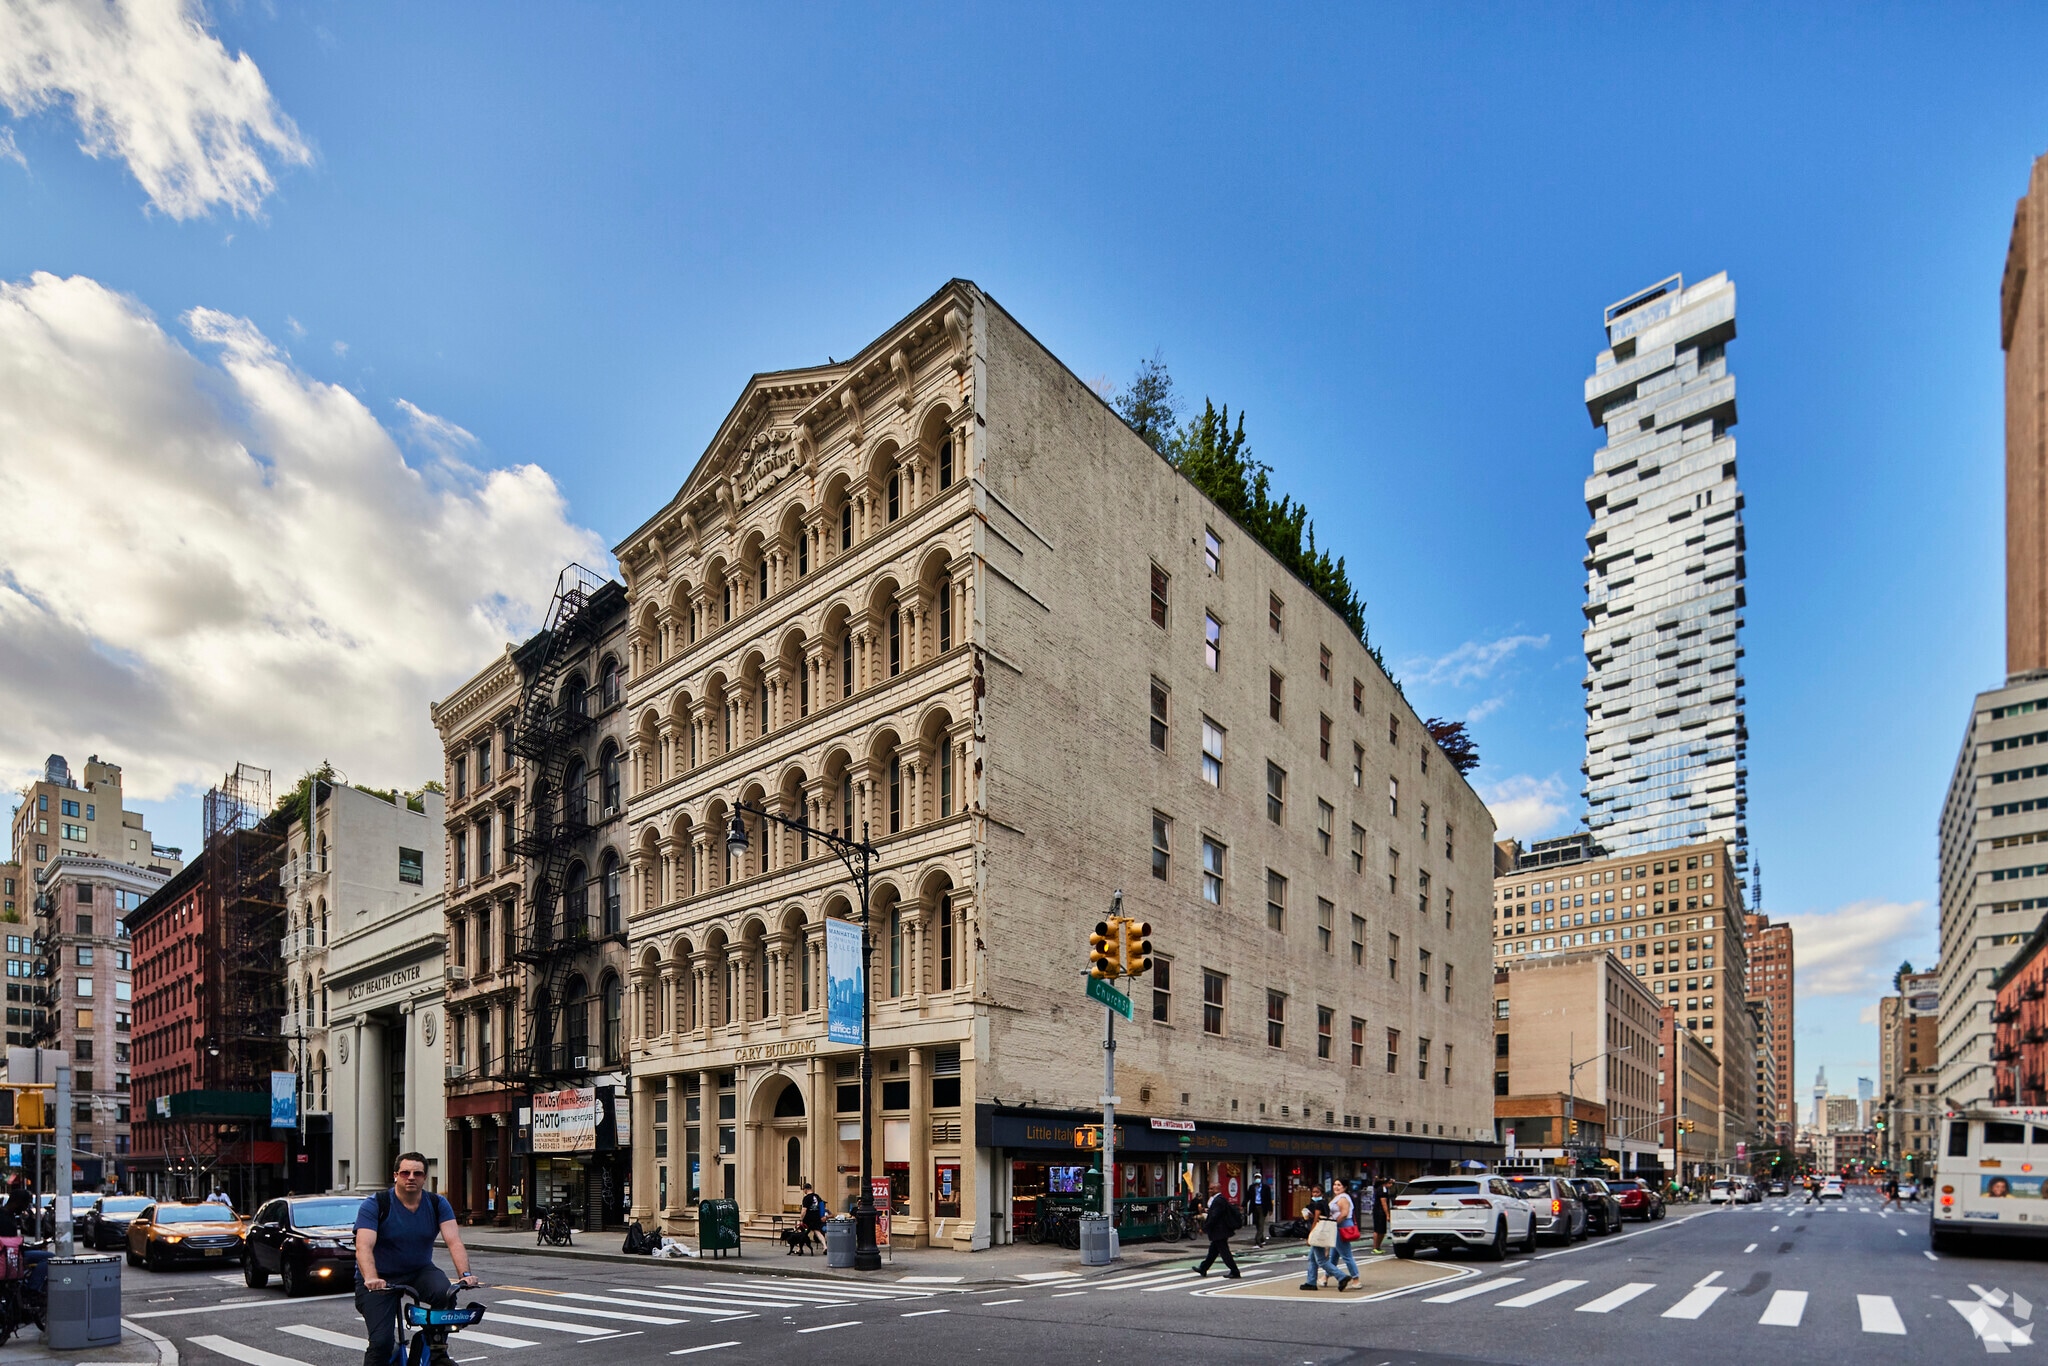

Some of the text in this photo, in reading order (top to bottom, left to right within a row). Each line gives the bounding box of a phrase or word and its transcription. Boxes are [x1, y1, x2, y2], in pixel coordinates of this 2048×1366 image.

[740, 448, 795, 497] BUILDING
[366, 976, 391, 994] HEALTH
[392, 966, 420, 986] CENTER
[1096, 984, 1121, 1008] Church
[735, 1040, 816, 1061] CARY BUILDING
[535, 1096, 560, 1108] TRILOGY
[535, 1113, 560, 1129] PHOTO
[1027, 1125, 1074, 1144] Little Italy
[872, 1187, 889, 1196] ZZA
[1131, 1204, 1148, 1212] Subway
